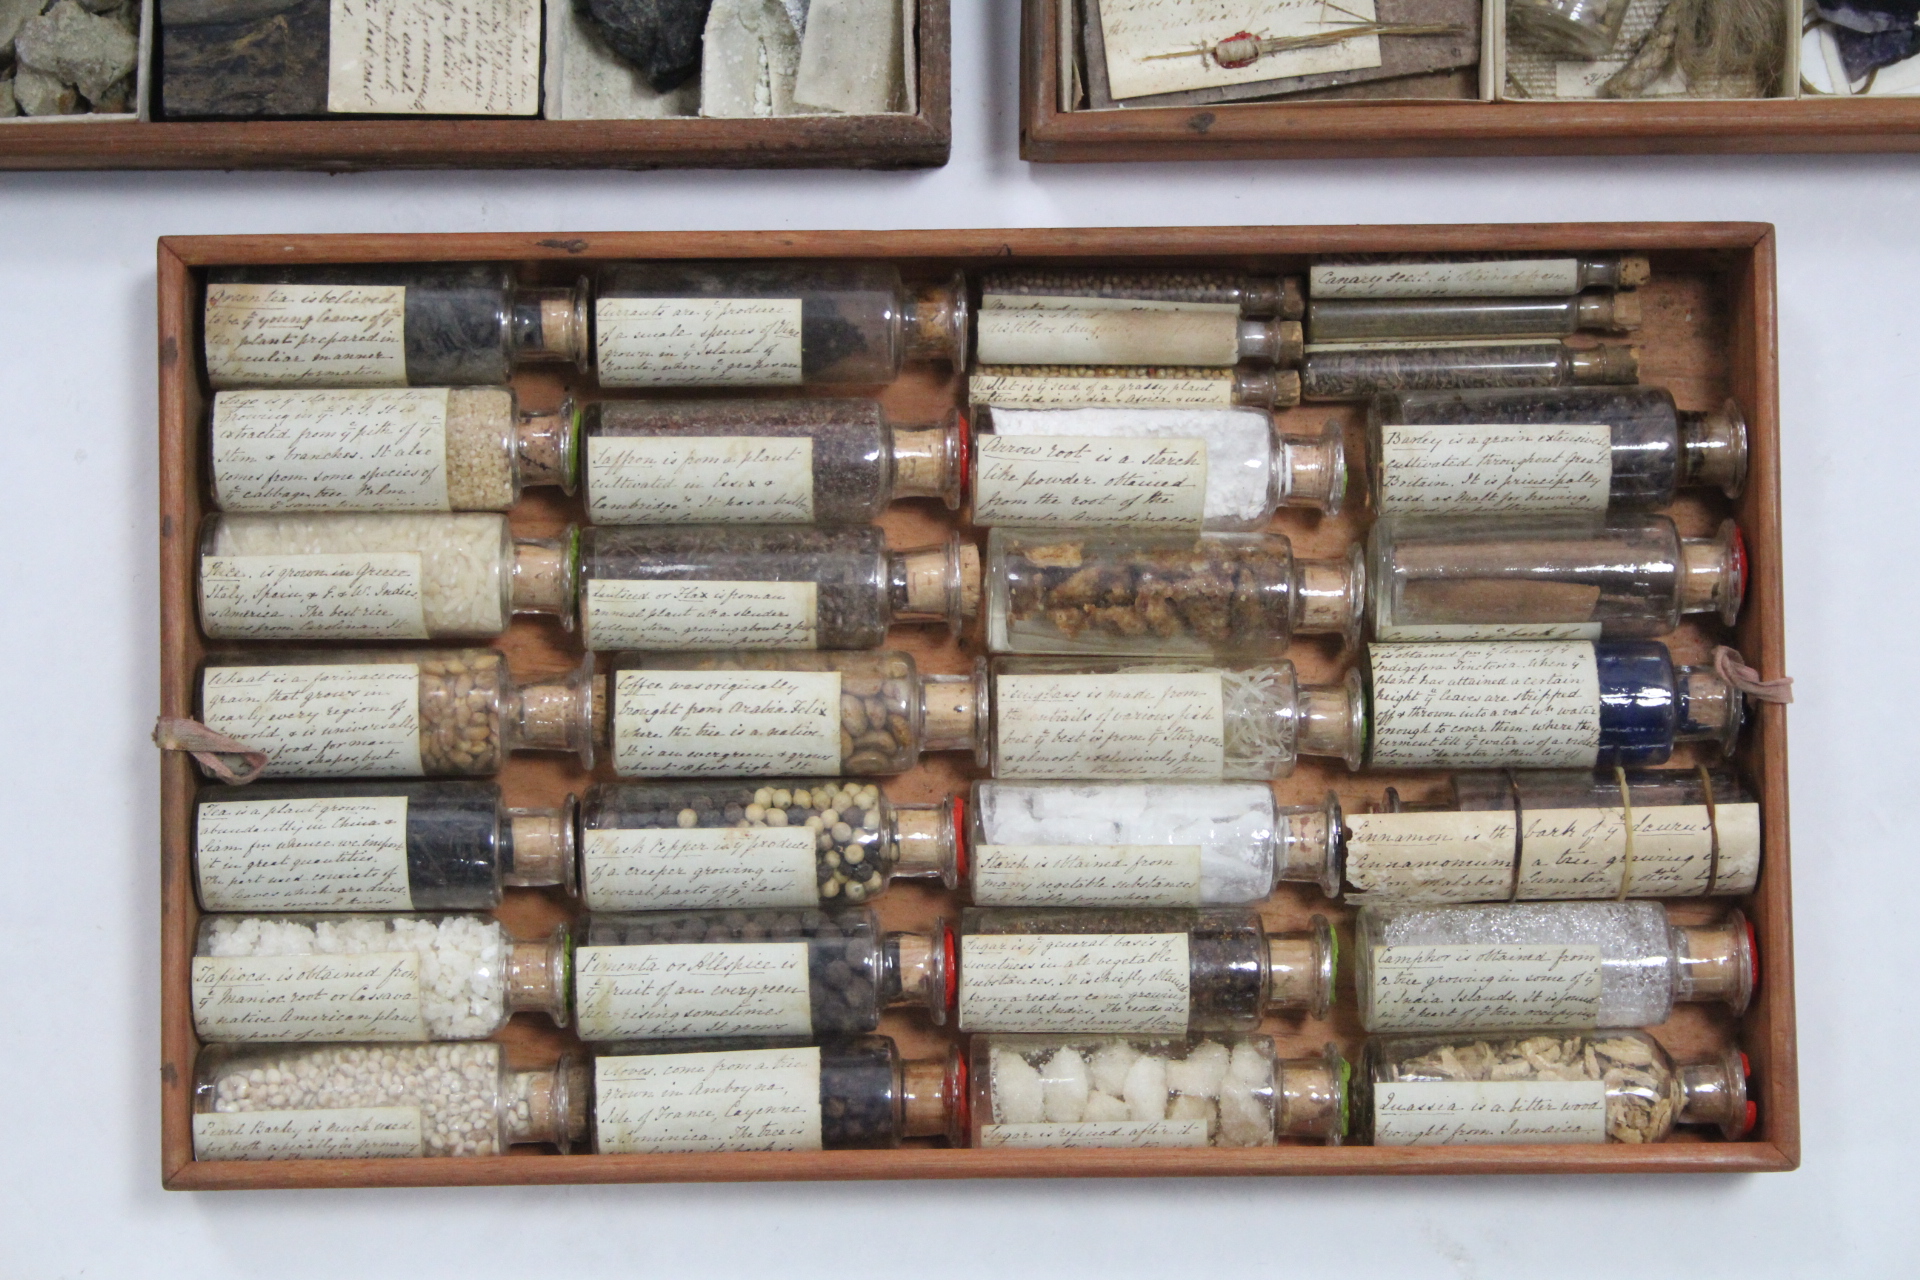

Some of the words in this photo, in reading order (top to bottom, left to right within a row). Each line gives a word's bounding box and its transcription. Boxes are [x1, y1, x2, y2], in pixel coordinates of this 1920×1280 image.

[1318, 271, 1382, 289] Canary
[319, 290, 397, 303] believed
[597, 302, 670, 316] Currants
[234, 334, 297, 350] plant
[294, 332, 379, 350] prepared
[970, 377, 1019, 391] Millet
[1117, 382, 1169, 394] grassy
[1171, 382, 1214, 394] plant
[221, 424, 291, 439] extracted
[394, 443, 431, 457] also
[983, 437, 1042, 452] Arrow
[1047, 444, 1091, 458] root
[1142, 447, 1199, 465] starch
[1384, 431, 1442, 452] Barley
[1478, 431, 1533, 452] grain
[1537, 430, 1611, 454] extensively
[593, 447, 657, 475] Saffron
[675, 449, 719, 473] from
[736, 448, 801, 468] plant
[1387, 455, 1473, 468] cultivated
[1476, 452, 1563, 472] throughout
[220, 473, 260, 482] comes
[360, 463, 420, 485] species
[591, 476, 677, 488] cultivated
[983, 463, 1018, 480] like
[1016, 470, 1095, 491] powder
[1105, 471, 1196, 487] obtained
[1497, 471, 1601, 490] principally
[243, 486, 310, 503] cabbage
[1034, 493, 1062, 504] the
[1072, 494, 1116, 505] root
[1143, 490, 1174, 504] the
[274, 568, 328, 586] grown
[673, 587, 708, 599] Flax
[330, 605, 357, 616] best
[592, 609, 644, 617] annual
[644, 606, 696, 620] plant
[734, 607, 789, 616] slender
[684, 624, 739, 635] growing
[740, 622, 782, 631] about
[208, 671, 270, 685] Wheat
[307, 672, 418, 688] farinaceous
[617, 676, 663, 696] Coffee
[704, 678, 799, 700] originally
[1375, 675, 1415, 689] plant
[1419, 675, 1444, 685] has
[1448, 675, 1507, 686] attained
[1524, 675, 1584, 684] certain
[206, 693, 259, 711] grain
[265, 689, 299, 702] that
[299, 689, 361, 708] grows
[1108, 689, 1155, 699] made
[1154, 686, 1206, 709] from
[1376, 689, 1423, 707] height
[1440, 690, 1481, 702] leaves
[1513, 689, 1582, 706] stripped
[208, 706, 265, 727] nearly
[269, 710, 319, 723] every
[326, 703, 385, 723] region
[621, 700, 682, 723] brought
[681, 703, 721, 721] from
[728, 700, 787, 713] Arabia
[1112, 706, 1174, 720] various
[1168, 705, 1214, 730] fish
[1407, 708, 1456, 718] thrown
[1460, 707, 1487, 718] into
[1560, 706, 1597, 715] water
[321, 715, 419, 736] universally
[767, 722, 824, 736] native
[1377, 723, 1431, 740] enough
[1532, 722, 1572, 732] where
[1572, 719, 1599, 734] they
[203, 804, 230, 817] Tea
[260, 803, 318, 820] plant
[315, 805, 376, 819] grown
[1524, 819, 1578, 838] bark
[587, 837, 644, 854] Black
[649, 838, 708, 859] Pepper
[740, 835, 813, 857] produce
[243, 855, 291, 874] great
[981, 851, 1028, 868] Starch
[1053, 854, 1128, 868] obtained
[1125, 855, 1178, 874] from
[1556, 849, 1597, 865] tree
[313, 867, 380, 880] consists
[625, 867, 686, 881] creeper
[690, 863, 764, 883] growing
[593, 885, 654, 895] several
[654, 885, 706, 899] parts
[982, 877, 1032, 891] many
[1036, 877, 1107, 891] vegetable
[1112, 876, 1197, 888] substances
[1042, 938, 1108, 956] general
[1114, 936, 1157, 946] basis
[688, 952, 776, 977] Allspice
[1097, 949, 1177, 969] vegetable
[1378, 948, 1451, 970] Camphor
[1477, 950, 1551, 961] obtained
[1548, 949, 1595, 971] from
[297, 964, 381, 980] obtained
[376, 959, 417, 989] from
[1094, 969, 1144, 988] chiefly
[1393, 972, 1421, 984] tree
[1421, 973, 1494, 992] growing
[218, 988, 286, 1004] Manioc
[290, 989, 329, 1002] root
[351, 985, 418, 1001] Cassava
[607, 980, 655, 996] fruit
[711, 984, 805, 1003] evergreen
[1391, 993, 1443, 1004] India
[216, 1010, 275, 1024] native
[280, 1008, 372, 1022] American
[366, 1008, 418, 1027] plant
[622, 1004, 679, 1024] rising
[684, 1004, 784, 1017] sometimes
[663, 1066, 705, 1075] come
[602, 1089, 654, 1105] grown
[1381, 1092, 1464, 1111] Quassia
[1509, 1096, 1557, 1112] bitter
[1561, 1100, 1602, 1111] wood
[199, 1121, 243, 1136] Pearl
[250, 1120, 302, 1138] Barley
[326, 1117, 370, 1132] much
[984, 1125, 1032, 1147] Sugar
[1129, 1123, 1173, 1142] after
[1379, 1122, 1448, 1145] brought
[1442, 1123, 1492, 1144] from
